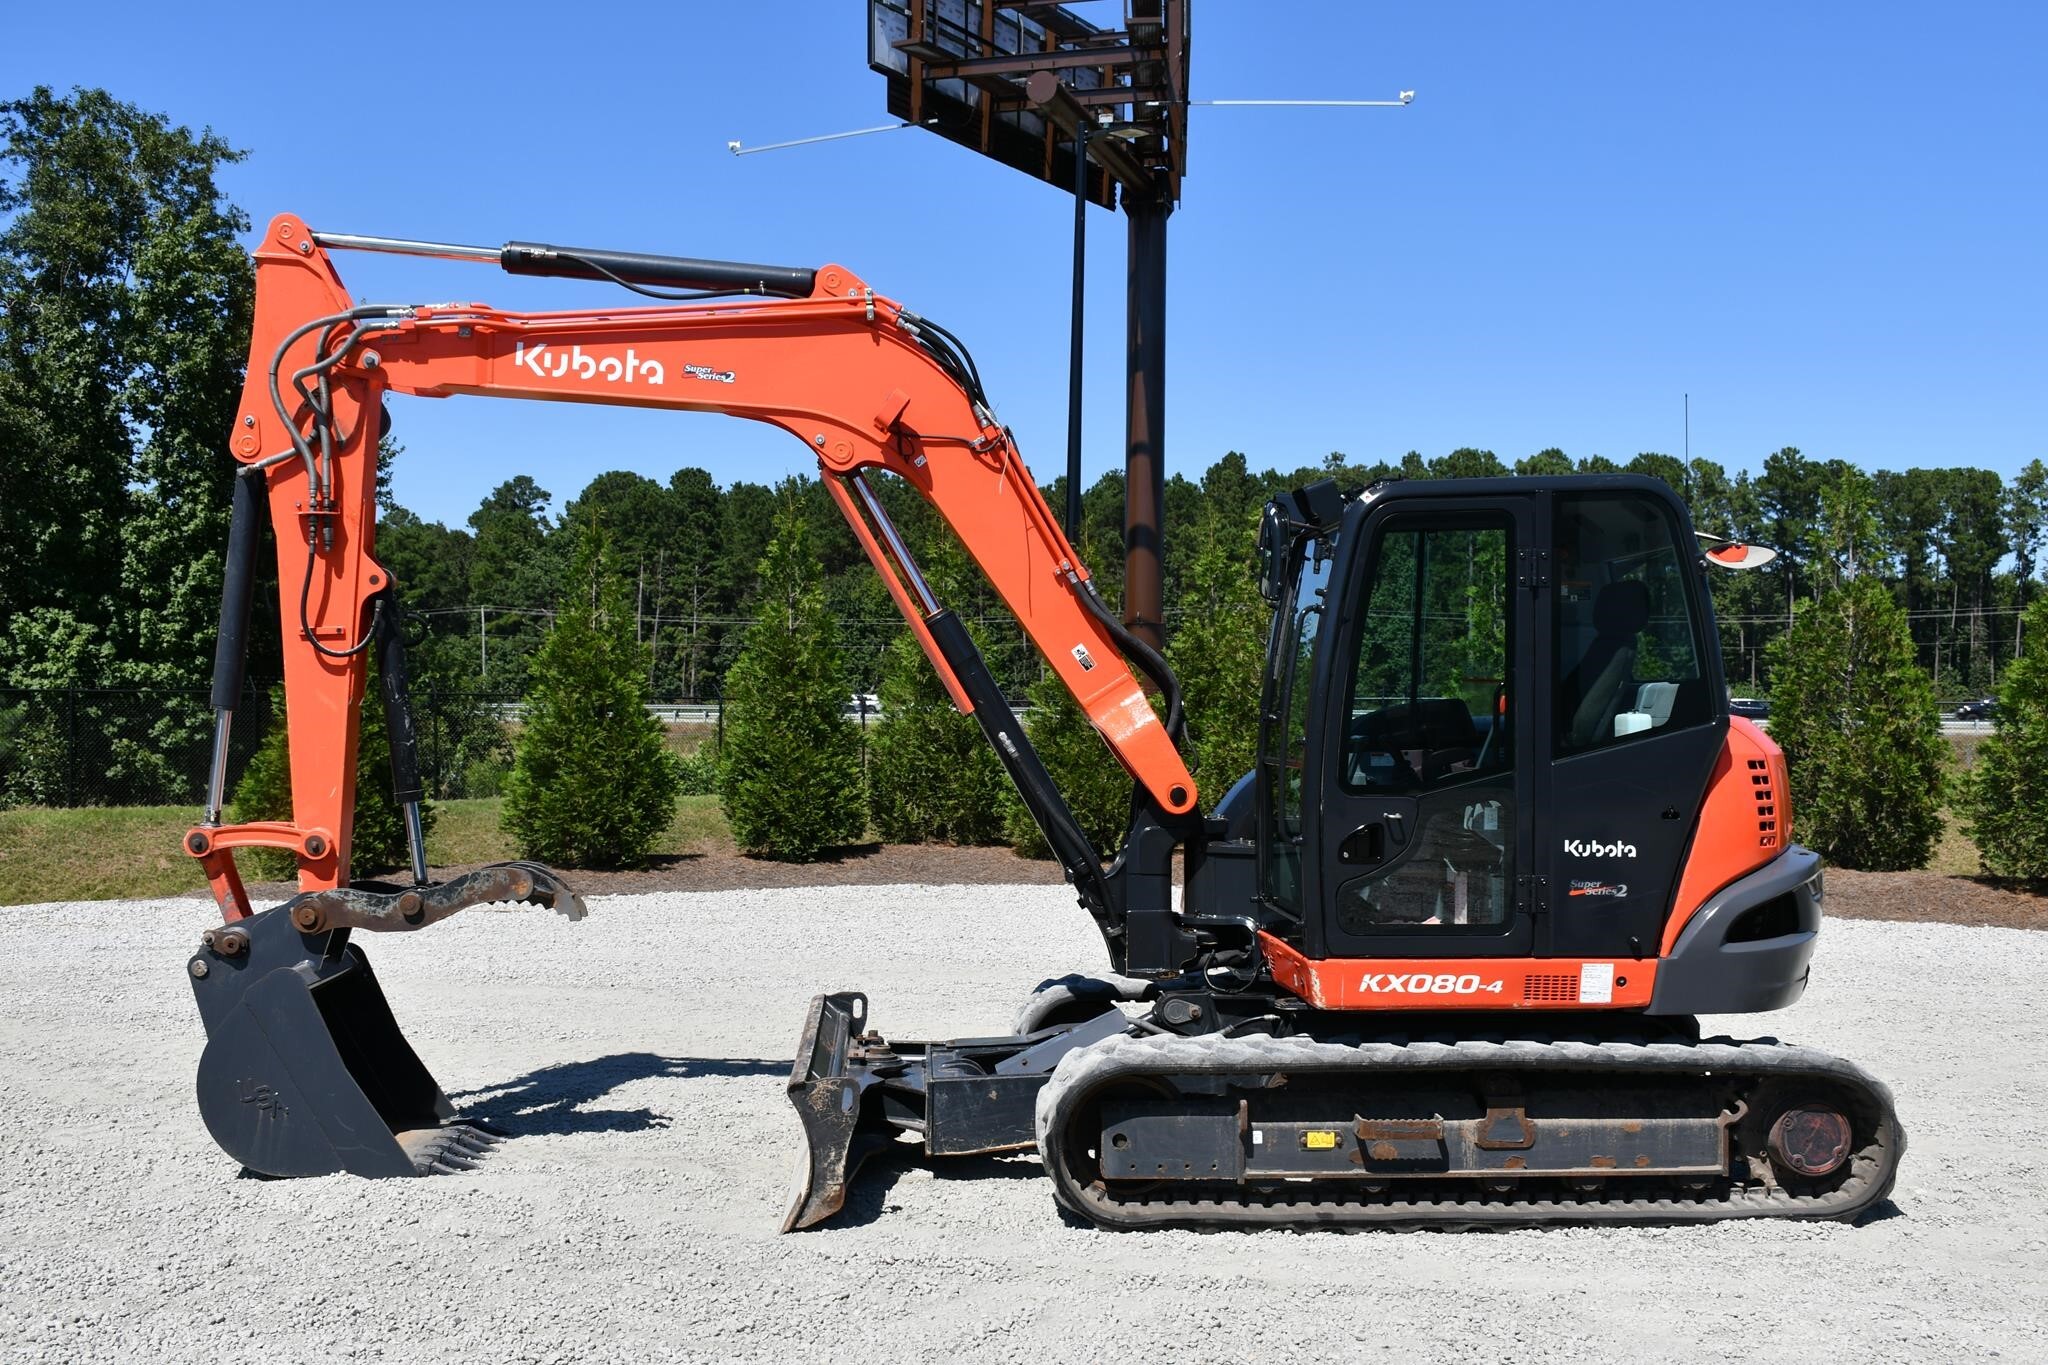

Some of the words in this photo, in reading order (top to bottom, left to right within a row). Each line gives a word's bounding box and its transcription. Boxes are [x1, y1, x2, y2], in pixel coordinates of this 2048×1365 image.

[515, 341, 664, 384] Kubota
[684, 364, 713, 374] Super
[1564, 839, 1637, 857] Kubota
[1570, 880, 1602, 888] Super
[1359, 974, 1503, 994] KX080-4
